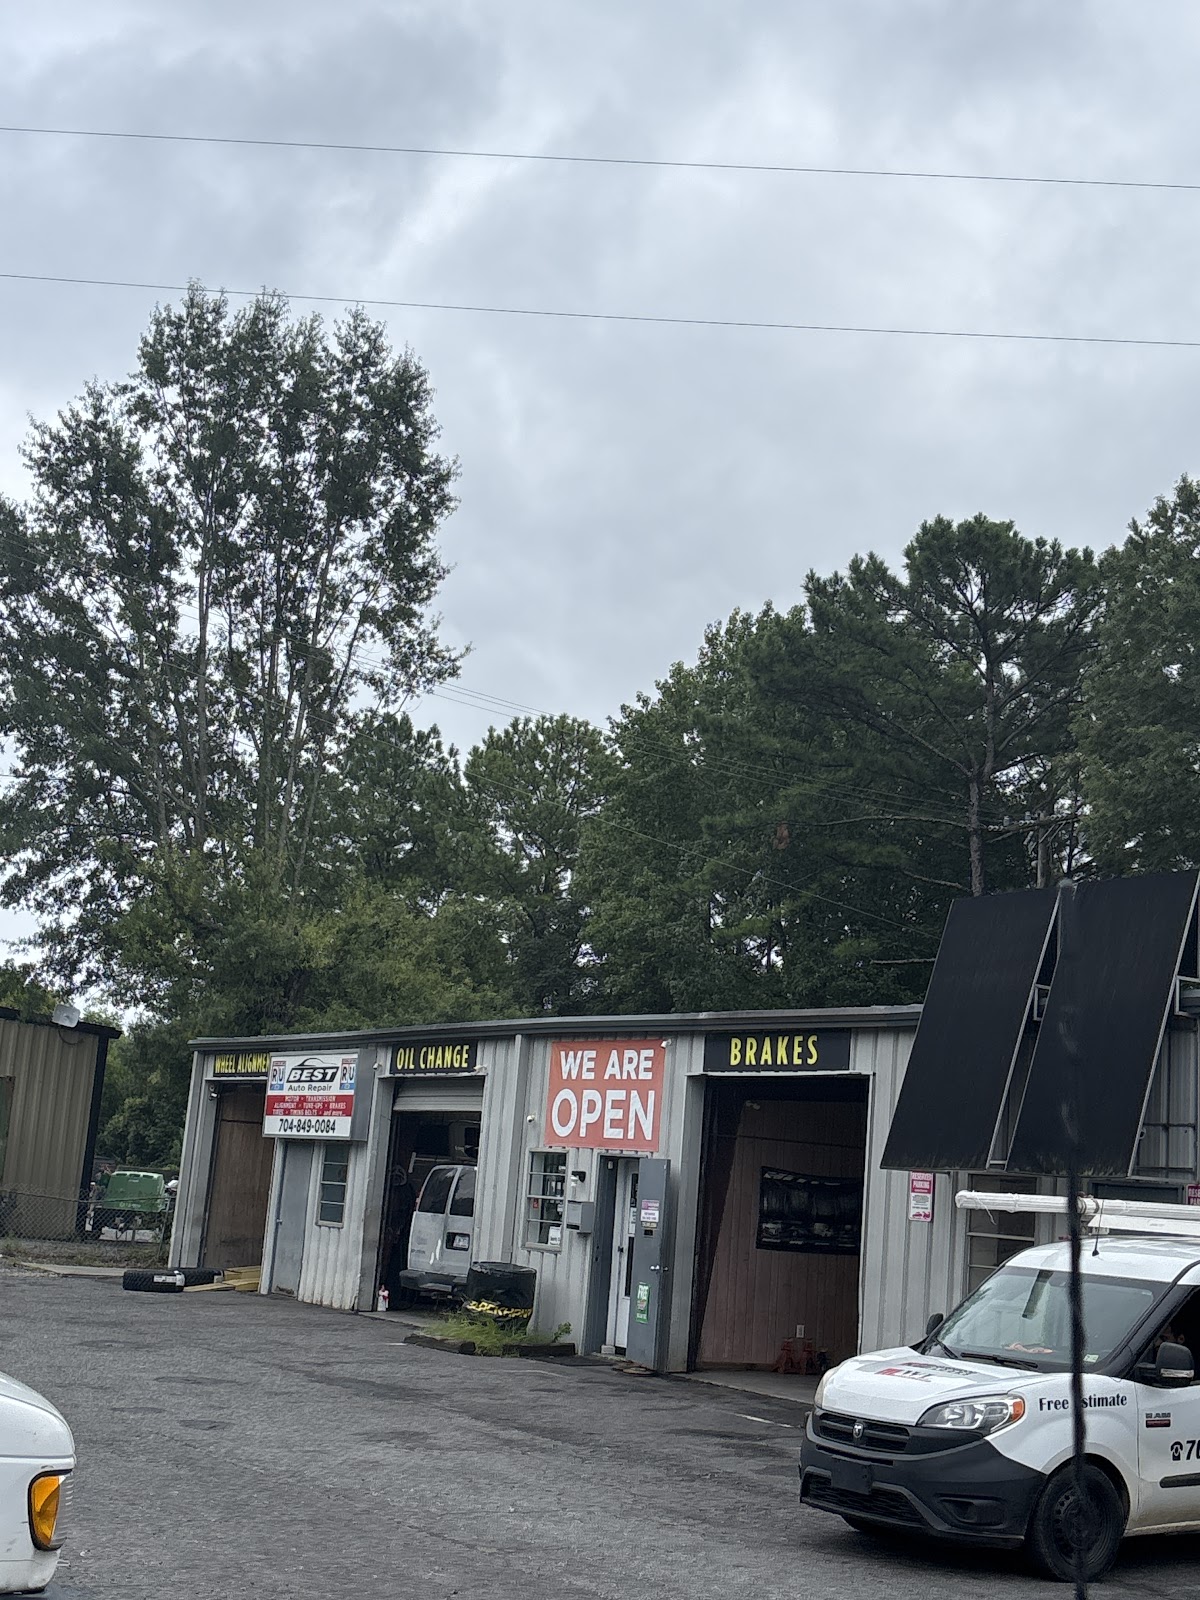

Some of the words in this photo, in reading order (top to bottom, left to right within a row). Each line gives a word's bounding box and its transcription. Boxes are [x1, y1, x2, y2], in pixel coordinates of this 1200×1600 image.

[396, 1047, 415, 1070] OIL
[420, 1044, 470, 1069] CHANGE
[729, 1034, 818, 1066] BRAKES
[214, 1054, 236, 1073] WHEEL
[236, 1053, 270, 1073] ALIGNMEN
[560, 1050, 597, 1080] WE
[603, 1049, 655, 1080] ARE
[288, 1068, 337, 1081] BEST
[287, 1084, 306, 1092] Auto
[307, 1084, 333, 1093] Repair
[551, 1088, 655, 1141] OPEN
[278, 1119, 336, 1133] 704-849-0084
[1038, 1397, 1070, 1412] Free
[1077, 1393, 1128, 1409] stimate
